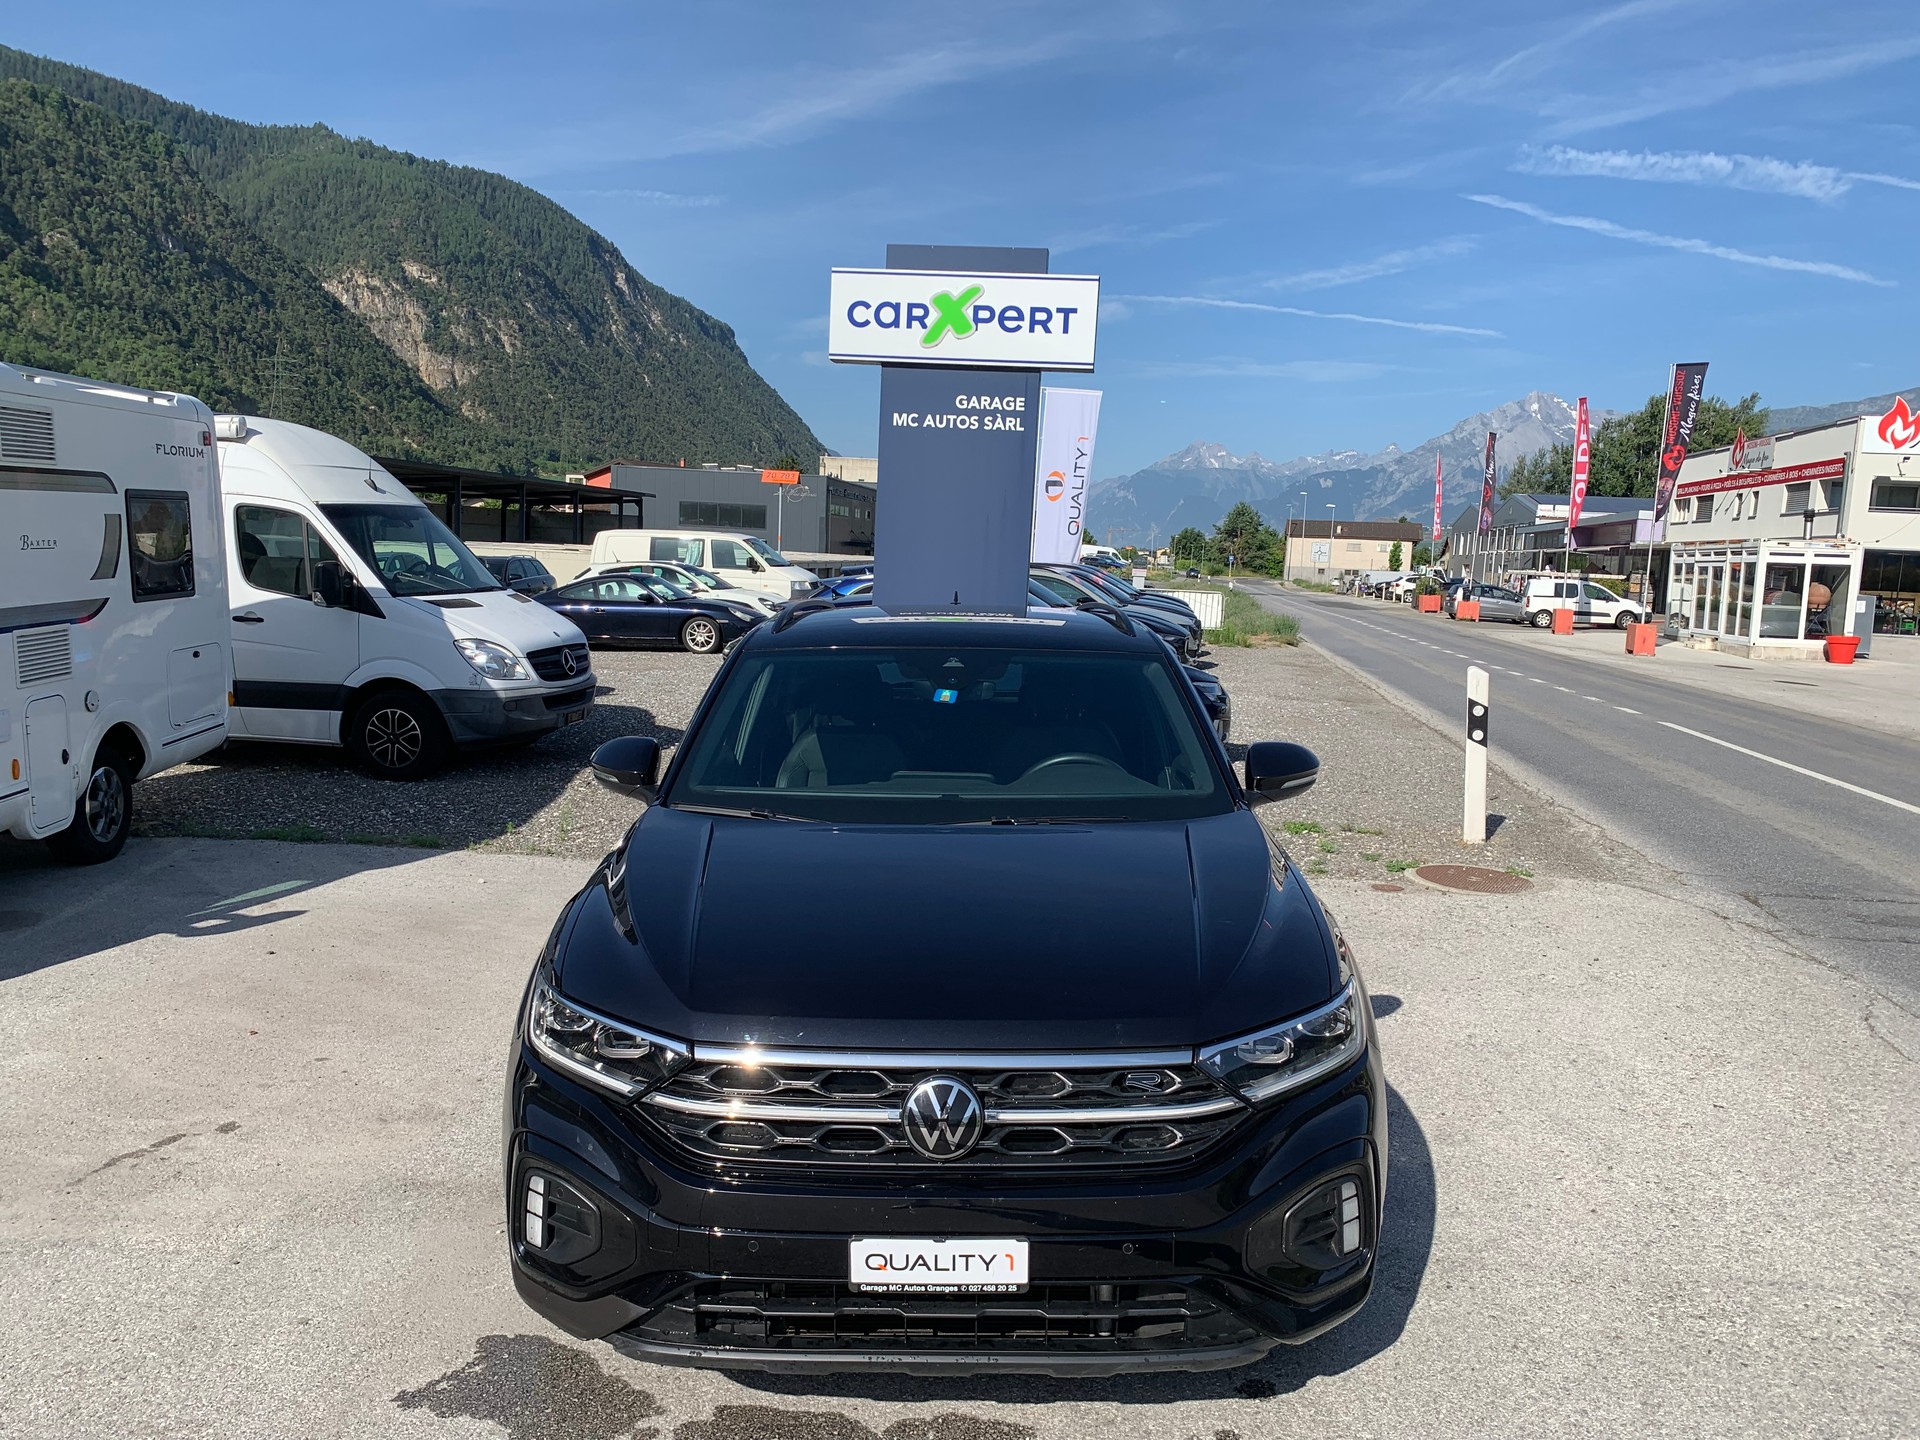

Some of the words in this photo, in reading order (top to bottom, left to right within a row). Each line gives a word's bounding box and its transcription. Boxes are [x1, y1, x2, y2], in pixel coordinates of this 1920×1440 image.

[955, 395, 1025, 411] GARAGE
[892, 412, 919, 427] MC
[922, 414, 979, 430] AUTOS
[983, 413, 1025, 431] SÀRL
[155, 443, 205, 458] FLORIUM
[1067, 447, 1088, 536] QUALITY
[865, 1253, 998, 1272] QUALITY
[1004, 1253, 1015, 1272] 1
[860, 1284, 887, 1293] Garage
[889, 1284, 903, 1292] MC
[903, 1284, 926, 1292] Autos
[926, 1284, 958, 1293] Granges
[968, 1284, 982, 1292] 027
[982, 1284, 997, 1292] 458
[997, 1284, 1007, 1292] 20
[1007, 1284, 1018, 1292] 25
